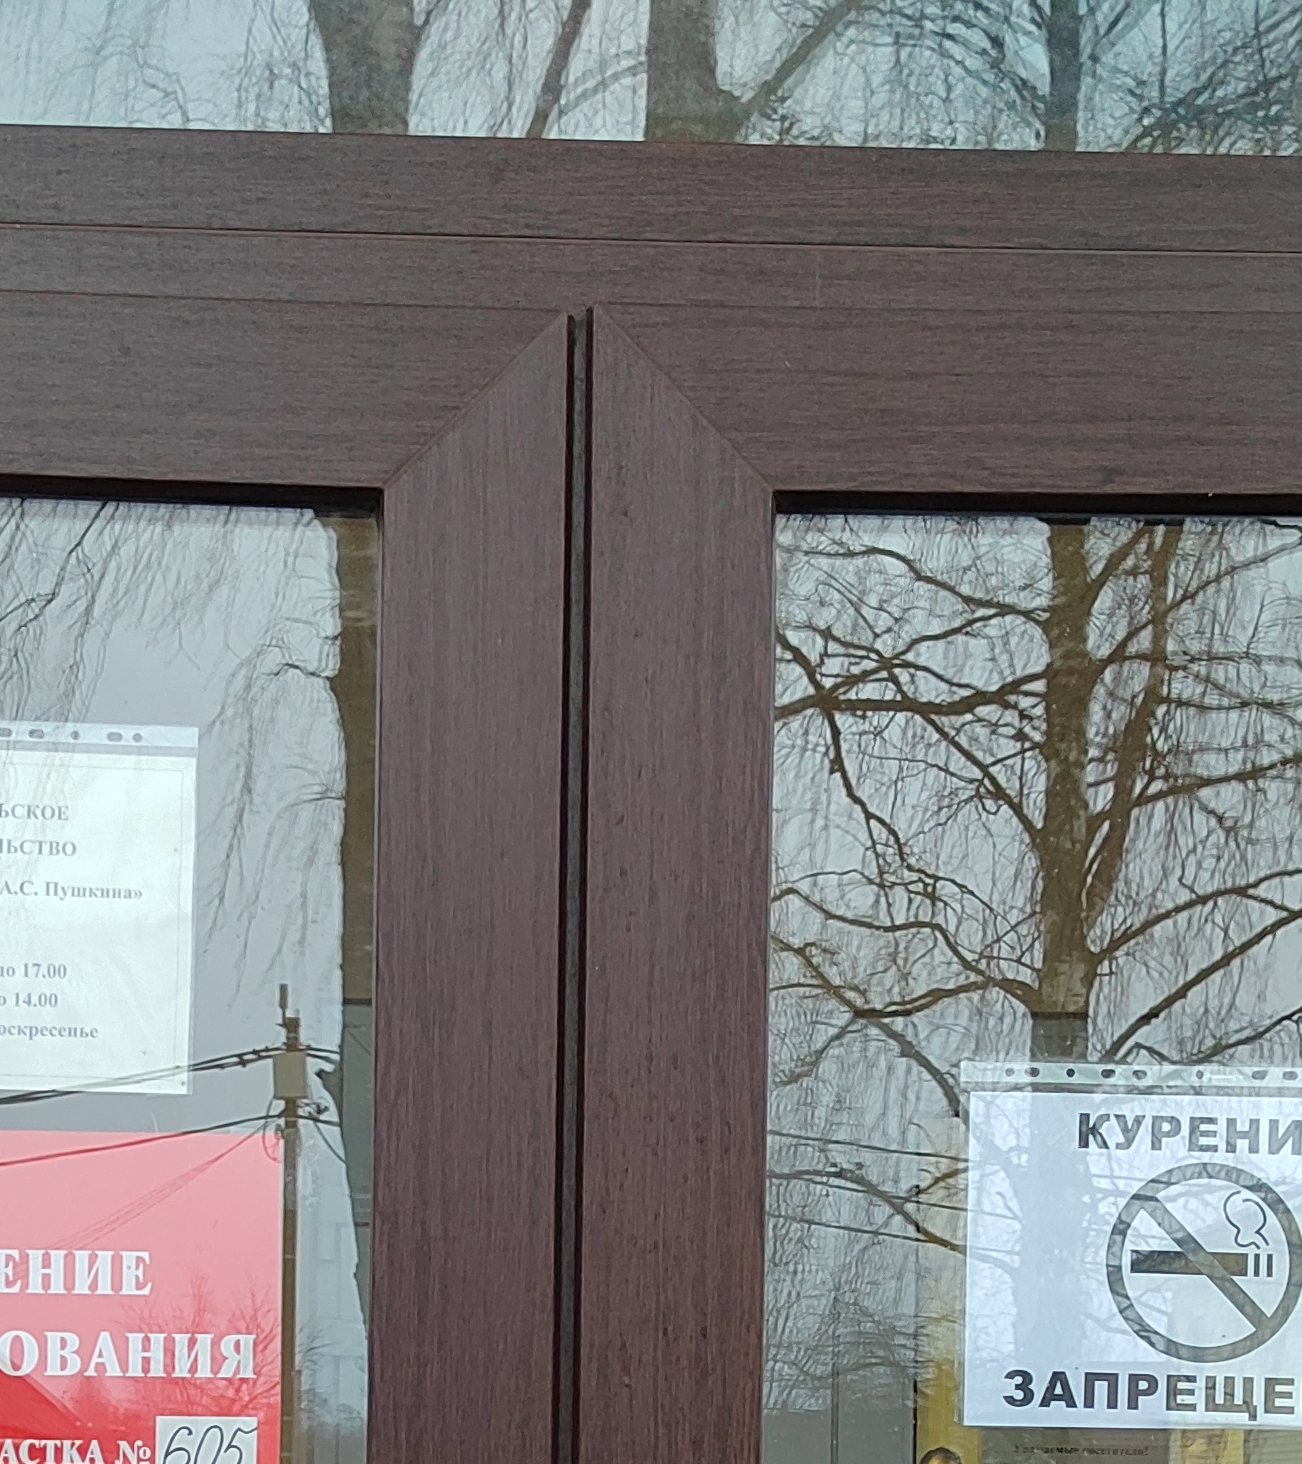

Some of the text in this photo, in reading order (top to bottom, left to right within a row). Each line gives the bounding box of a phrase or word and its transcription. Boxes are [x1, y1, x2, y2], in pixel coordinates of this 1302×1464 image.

[0, 880, 39, 896] А.С.
[44, 882, 143, 901] Пушкина»
[22, 963, 67, 980] 17.00
[13, 992, 58, 1008] 14.00
